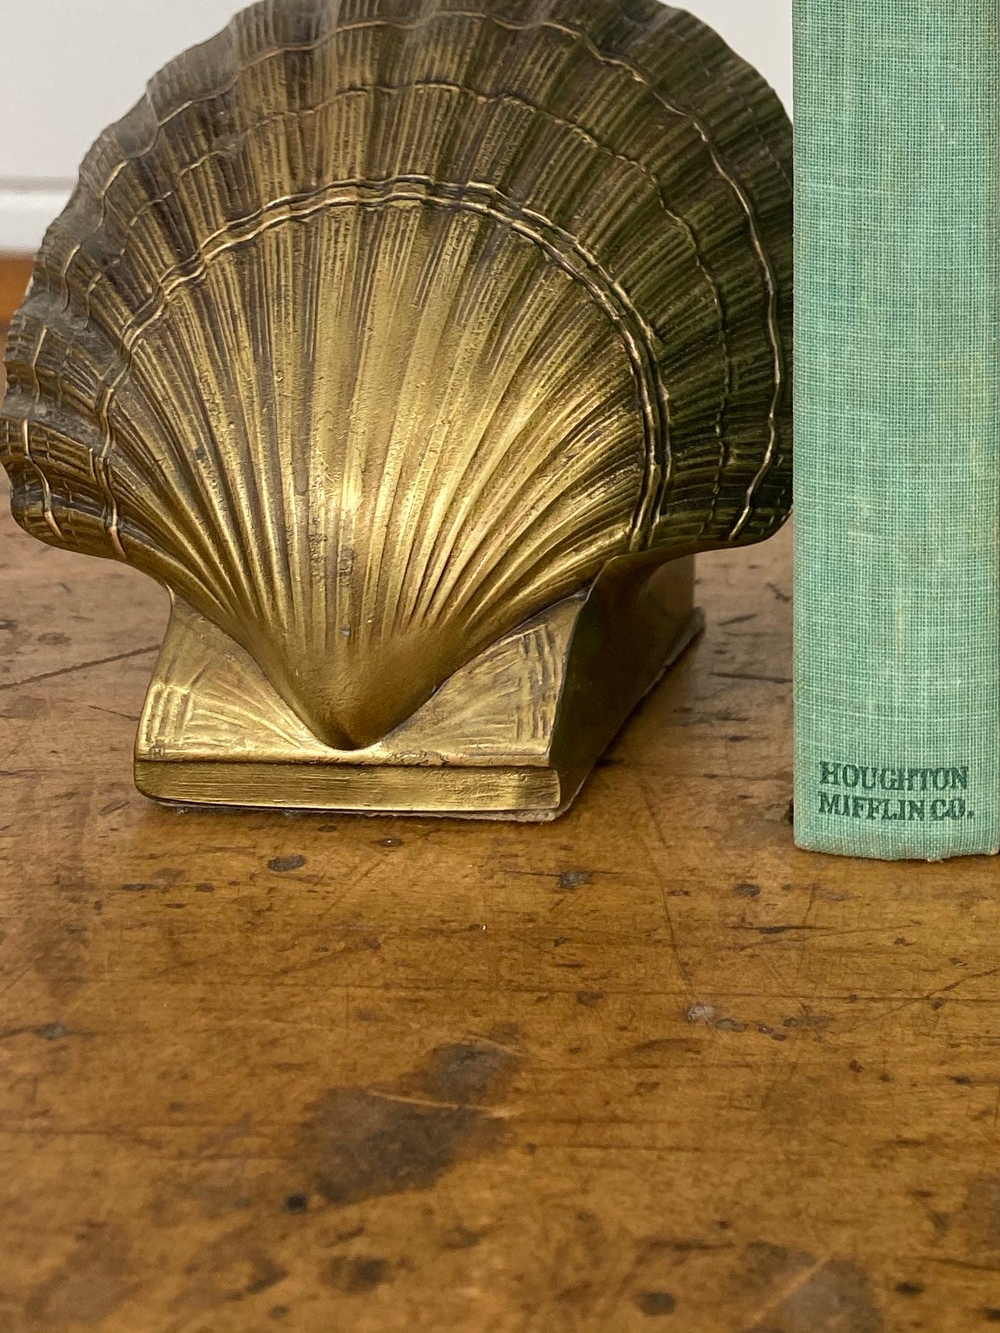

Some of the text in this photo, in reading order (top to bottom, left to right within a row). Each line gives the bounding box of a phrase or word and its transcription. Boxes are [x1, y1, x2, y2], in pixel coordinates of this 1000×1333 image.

[820, 761, 969, 791] HOUGHTON
[818, 792, 974, 821] MIFFLIN CO.
